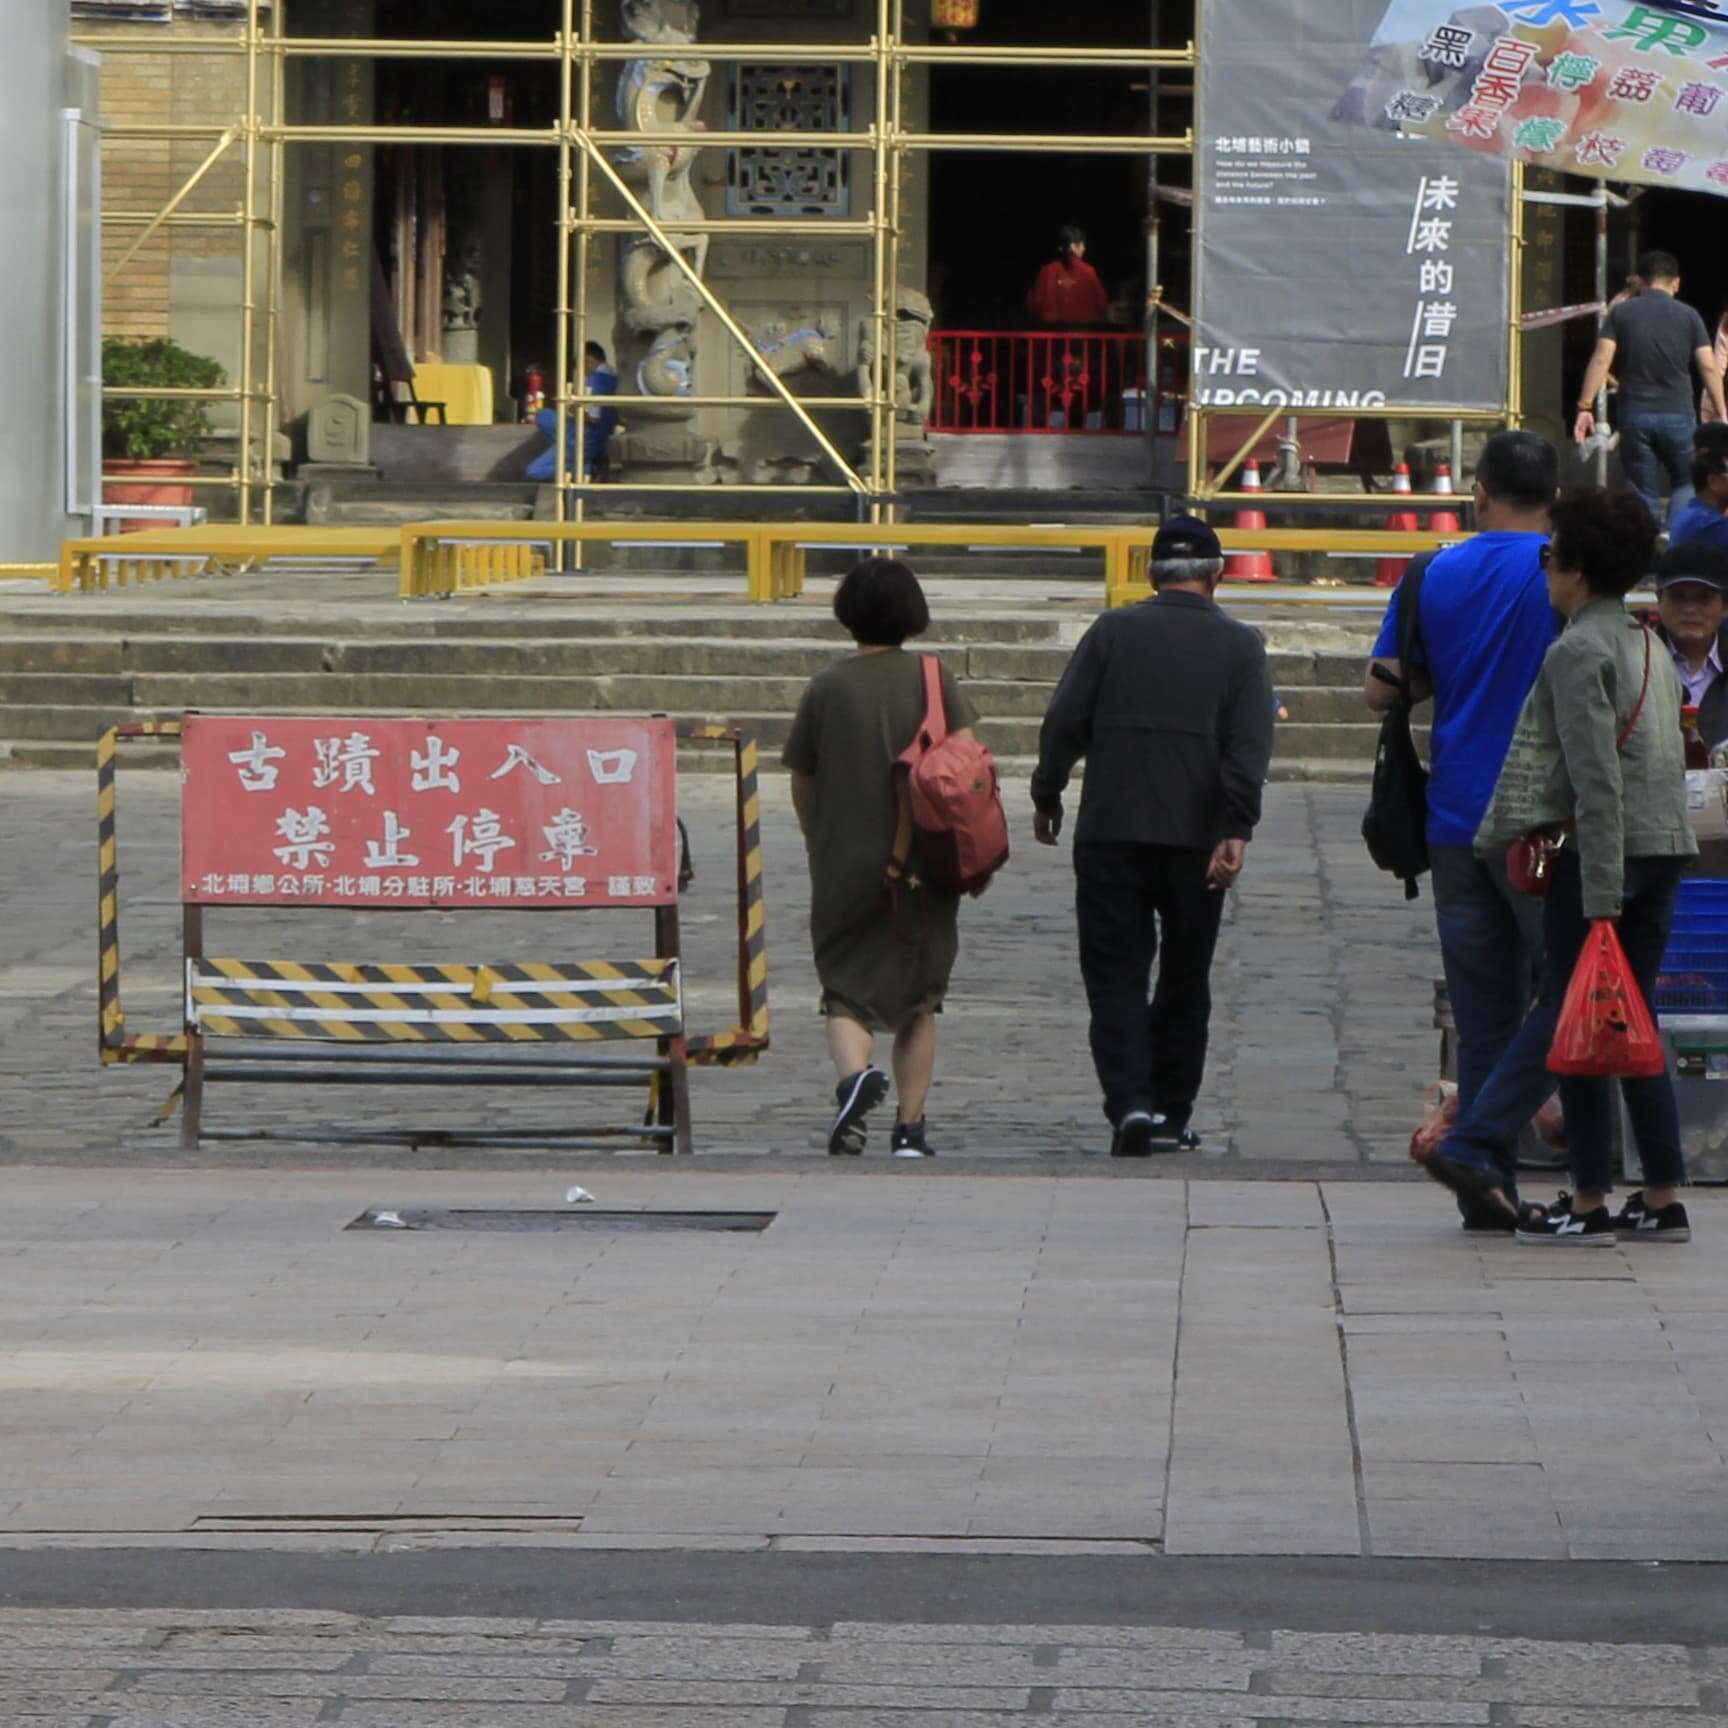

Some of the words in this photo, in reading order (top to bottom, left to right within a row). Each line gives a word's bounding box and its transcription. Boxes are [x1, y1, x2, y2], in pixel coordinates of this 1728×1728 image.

[1447, 37, 1540, 138] 百香果
[1413, 175, 1459, 378] 未來的昔日
[1193, 347, 1261, 375] THE
[228, 731, 640, 795] 古蹟出入口
[272, 807, 600, 872] 禁止停車
